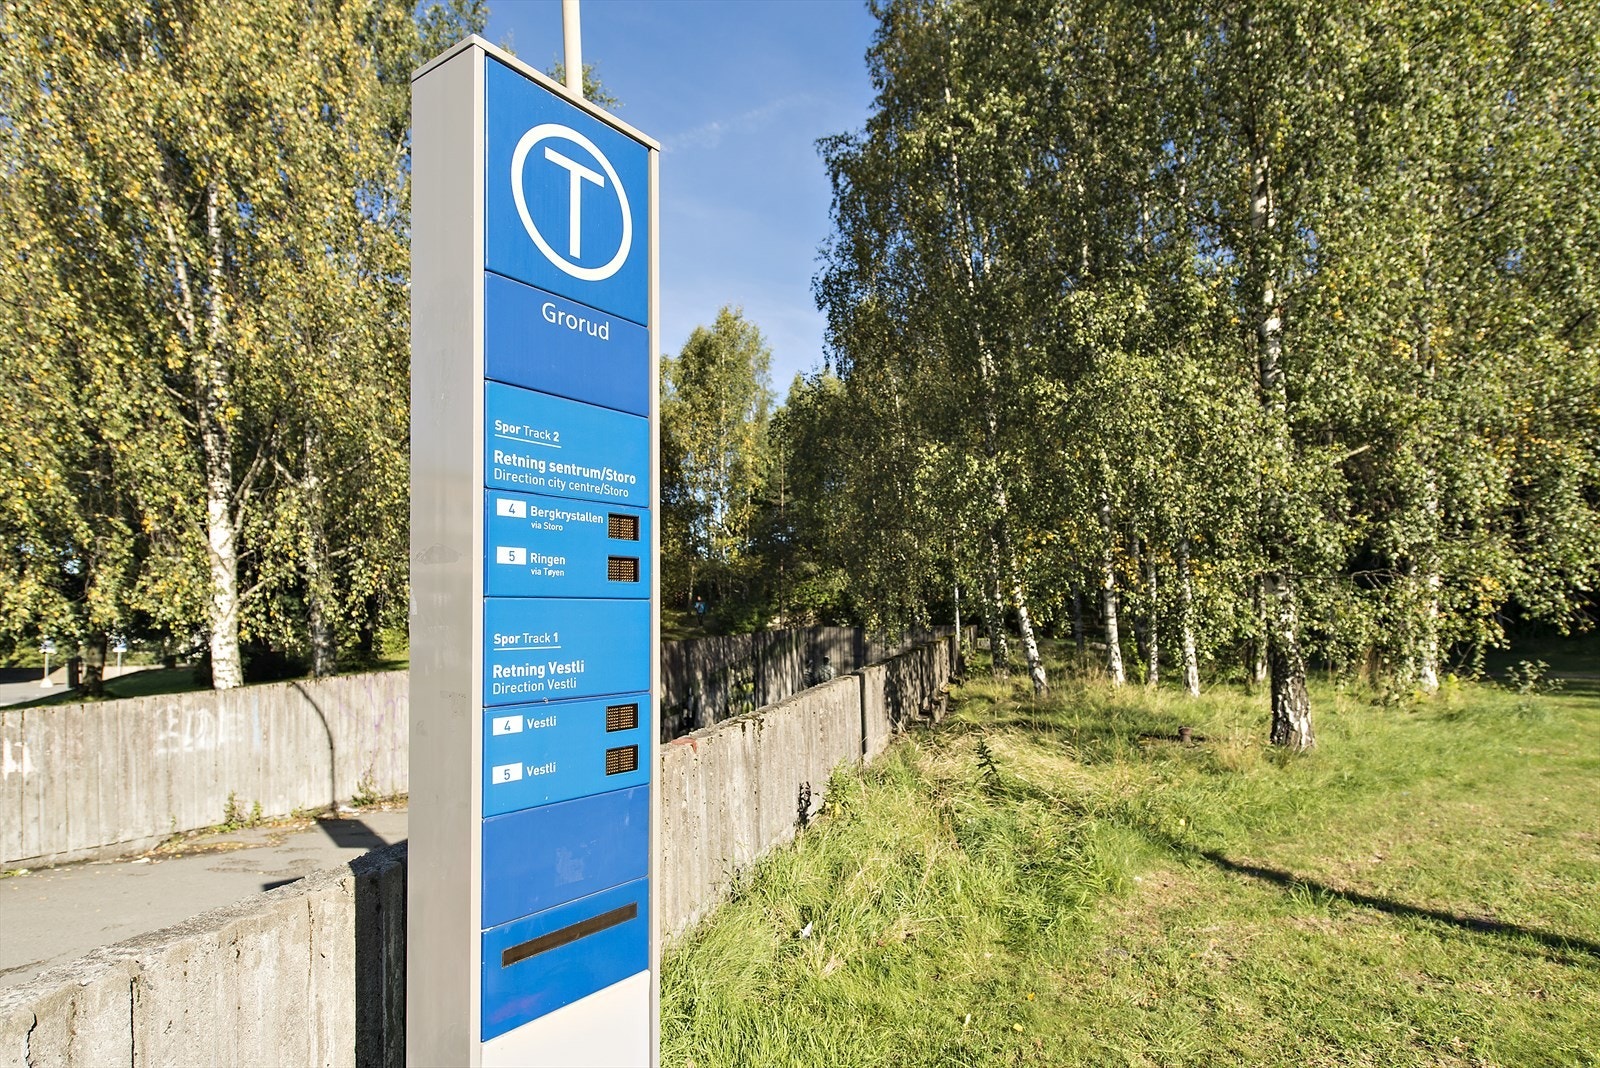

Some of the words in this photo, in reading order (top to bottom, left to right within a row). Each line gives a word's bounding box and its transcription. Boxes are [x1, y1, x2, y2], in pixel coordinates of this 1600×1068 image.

[544, 146, 605, 259] T
[542, 302, 609, 341] Grorud
[495, 420, 521, 434] Spor
[523, 425, 551, 440] Track
[553, 432, 560, 442] 2
[494, 450, 546, 473] Retning
[549, 462, 636, 484] sentrum/Storo
[494, 468, 545, 486] Direction
[548, 477, 566, 491] city
[569, 482, 629, 497] centre/Storo
[508, 503, 516, 514] 4
[530, 506, 603, 524] Bergkrystallen
[543, 522, 563, 531] Storo
[508, 551, 515, 561] 5
[530, 552, 566, 566] Ringen
[543, 568, 564, 577] Tøyen
[493, 633, 520, 646] Spor
[523, 632, 551, 643] Track
[553, 632, 558, 642] 1
[493, 662, 545, 678] Retning
[548, 660, 585, 674] Vestli
[493, 681, 544, 695] Direction
[548, 678, 577, 689] Vestli
[504, 720, 511, 731] 4
[527, 716, 557, 729] Vestli
[504, 769, 511, 780] 5
[527, 762, 556, 776] Vestli
